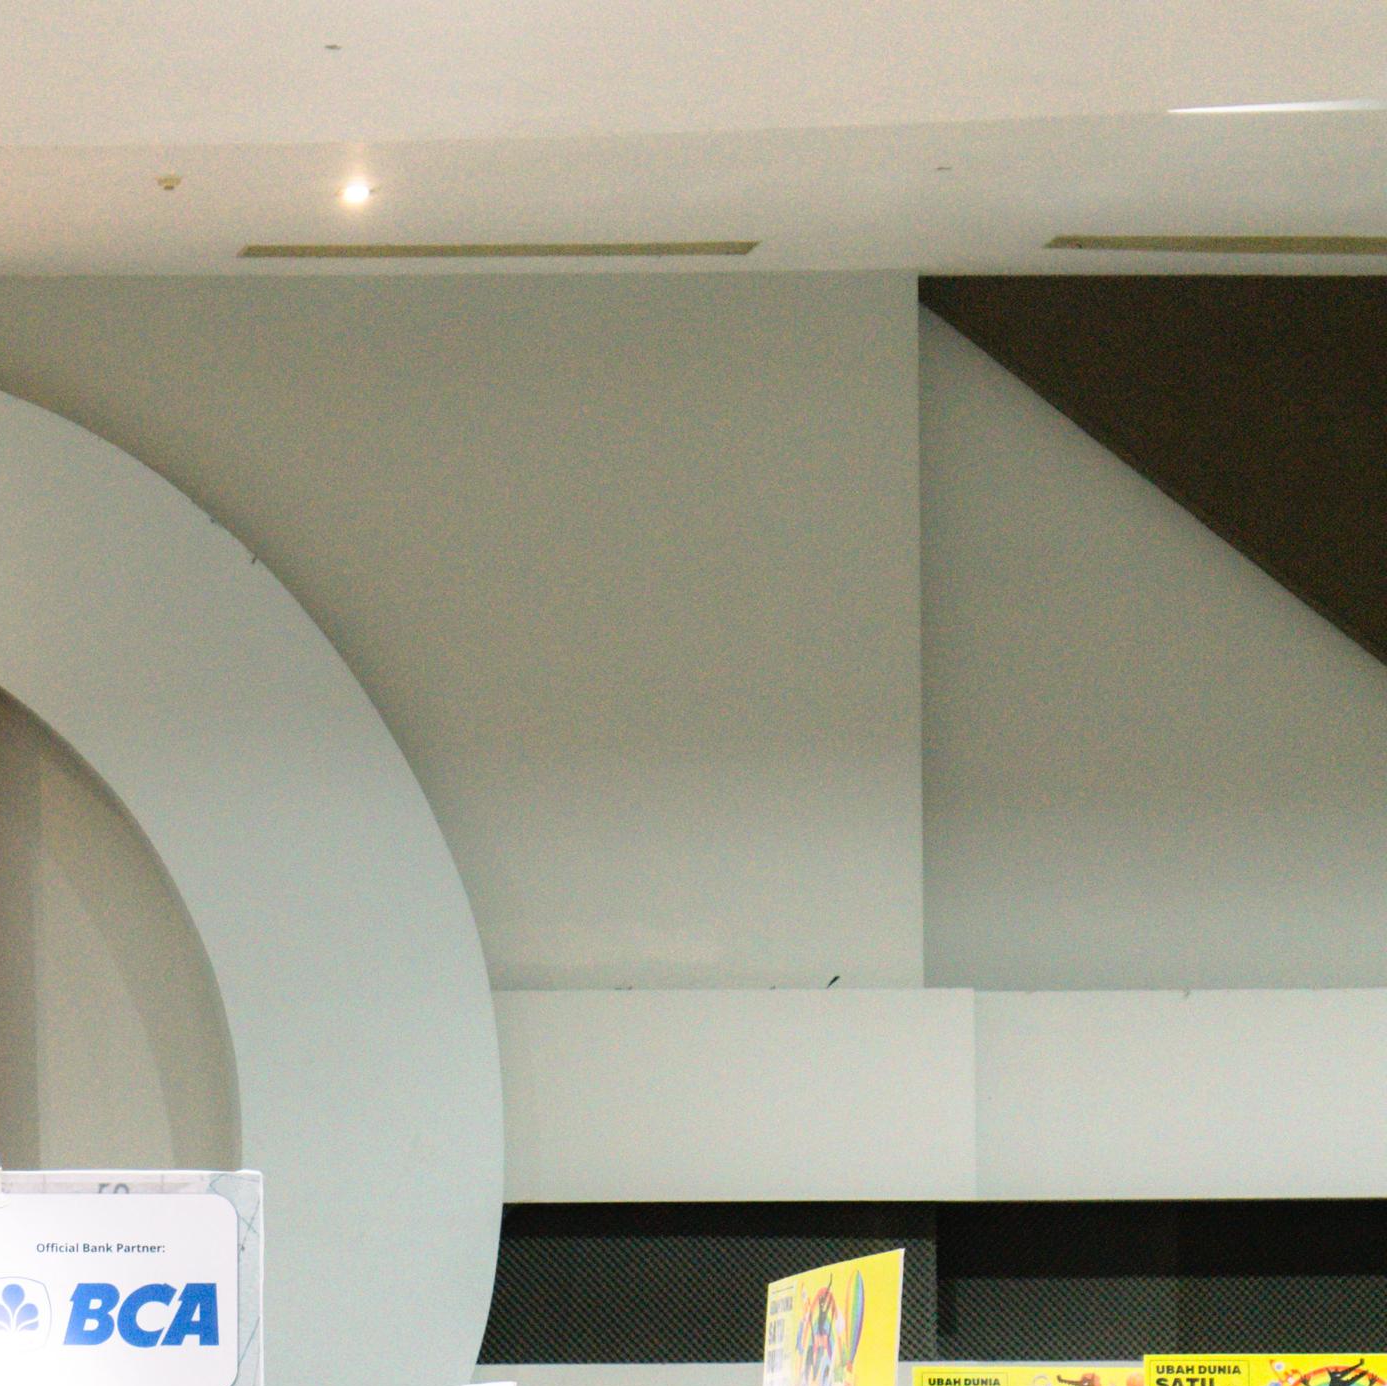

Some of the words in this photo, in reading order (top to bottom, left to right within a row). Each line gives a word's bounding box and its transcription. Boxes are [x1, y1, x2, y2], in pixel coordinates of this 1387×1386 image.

[36, 1243, 79, 1253] Official
[83, 1243, 112, 1253] Bank
[117, 1243, 165, 1253] Partner:
[64, 1283, 219, 1348] BCA
[1156, 1365, 1194, 1374] UBAH
[1198, 1365, 1241, 1374] DUNIA
[928, 1378, 961, 1386] UBAH
[964, 1378, 1000, 1386] DUNIA
